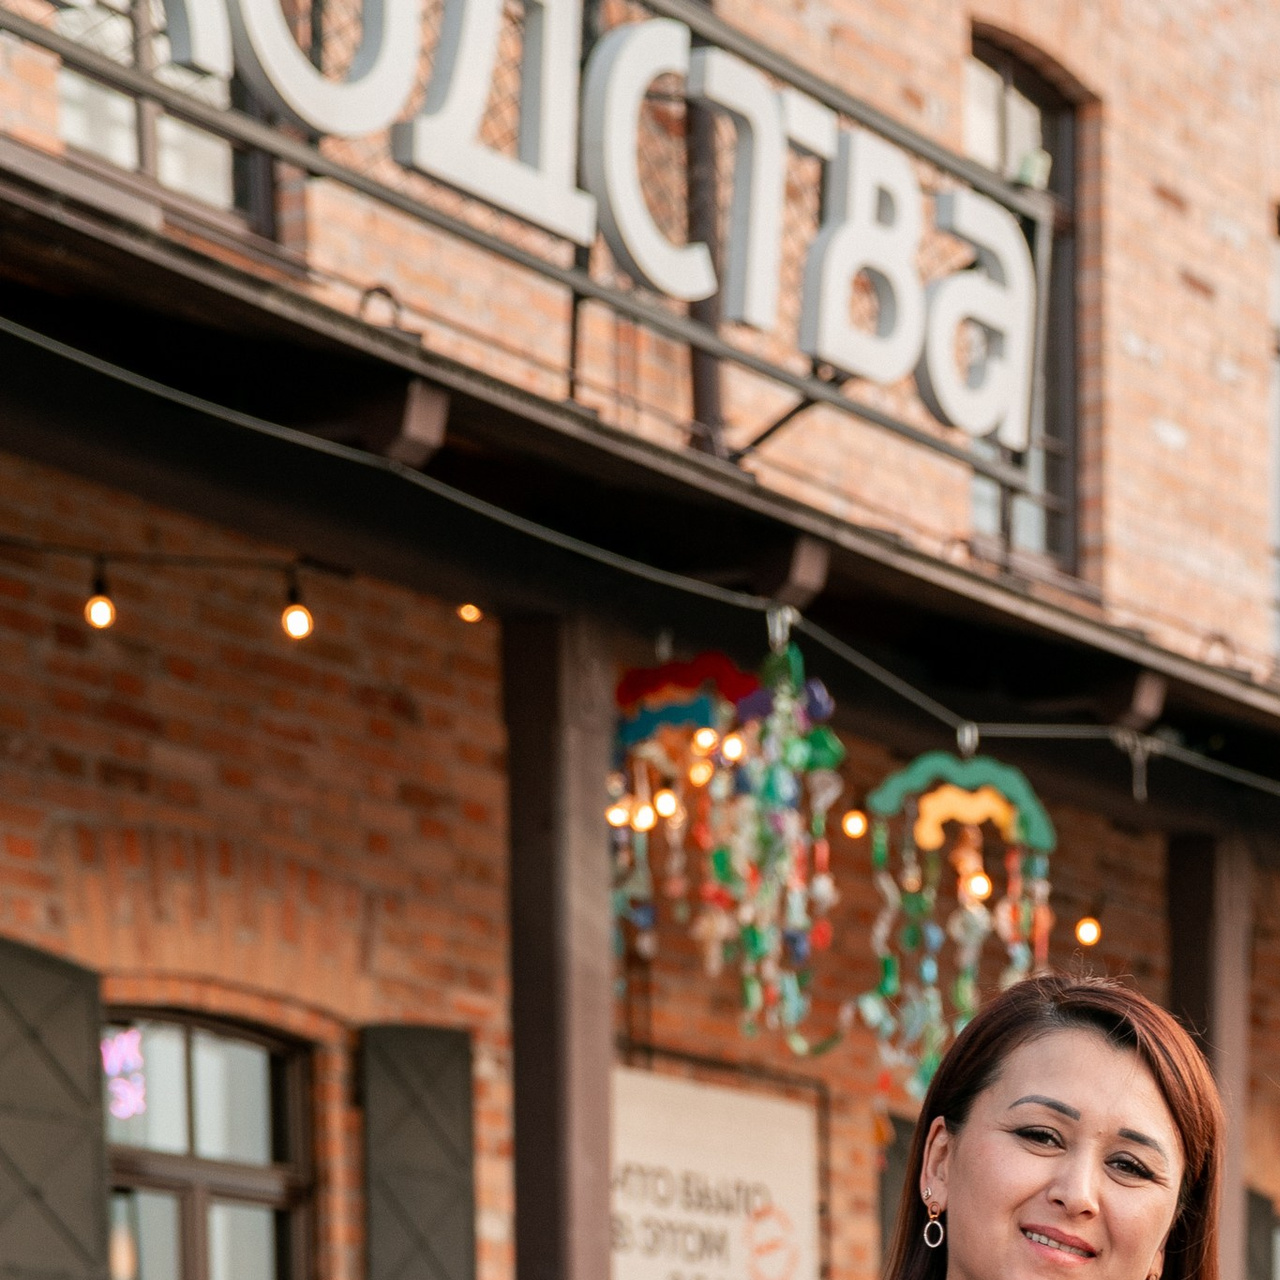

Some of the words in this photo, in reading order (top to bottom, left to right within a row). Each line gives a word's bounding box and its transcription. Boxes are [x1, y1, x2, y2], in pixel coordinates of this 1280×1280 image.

[164, 0, 1037, 452] дства
[681, 1169, 773, 1217] БЫЛО
[639, 1216, 731, 1264] ЭТОМ
